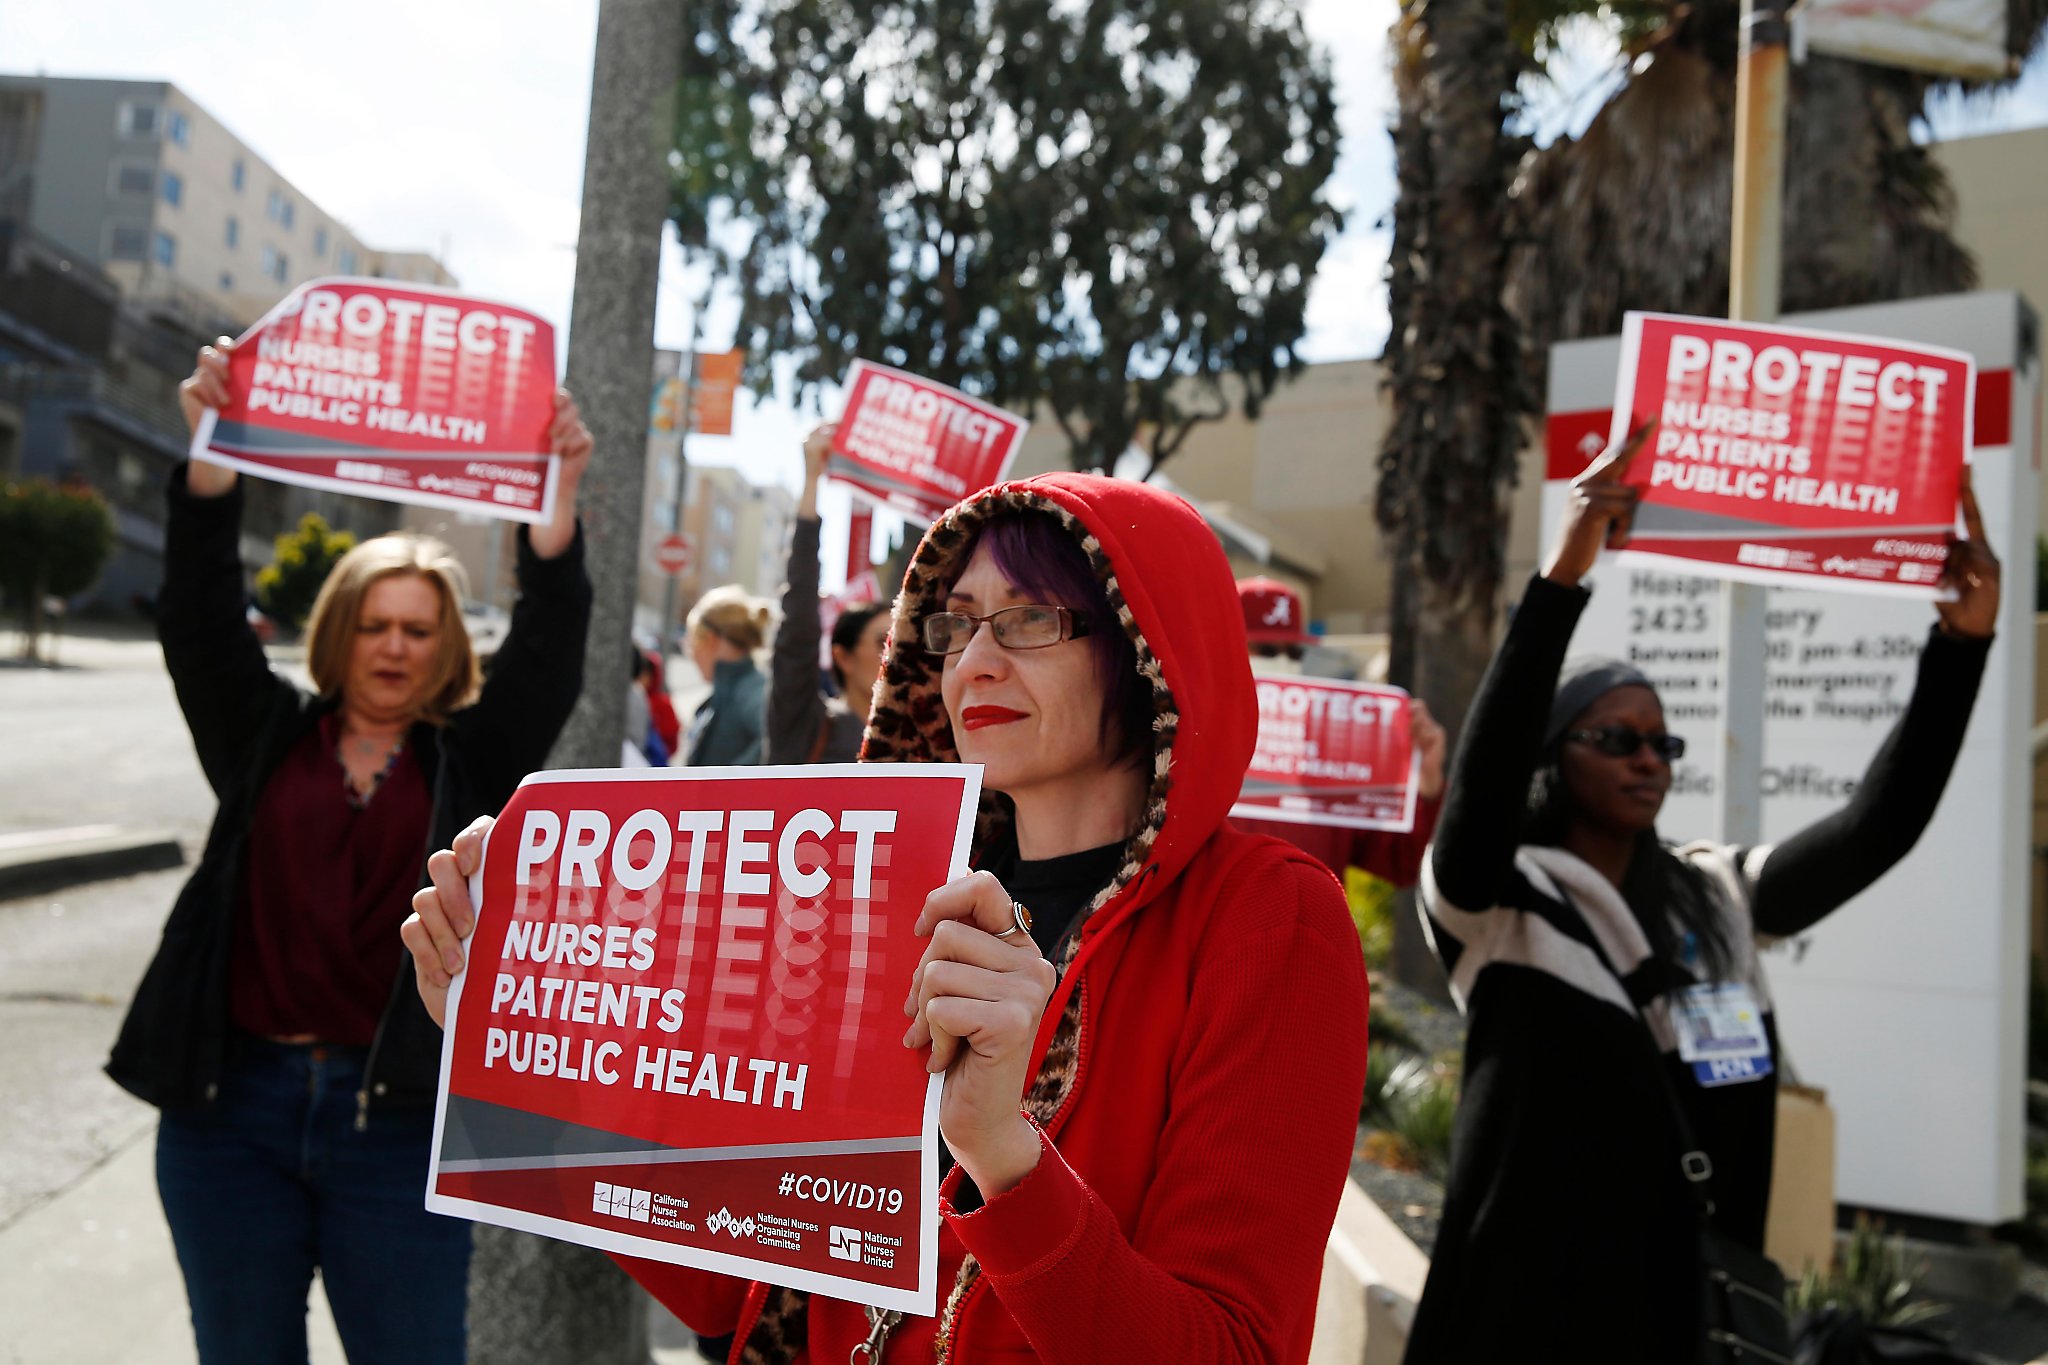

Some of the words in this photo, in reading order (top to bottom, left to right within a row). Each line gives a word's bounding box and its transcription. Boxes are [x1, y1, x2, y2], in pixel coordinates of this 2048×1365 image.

[258, 336, 381, 377] NURSES
[1666, 334, 1948, 415] PROTECT
[253, 362, 402, 406] PATIENTS
[247, 387, 361, 425] PUBLIC
[366, 406, 487, 444] HEALTH
[863, 374, 1006, 451] PROTECT
[1661, 400, 1791, 440] NURSES
[1656, 430, 1812, 474] PATIENTS
[1651, 459, 1768, 499] PUBLIC
[1773, 475, 1900, 515] HEALTH
[1631, 604, 1709, 634] 2425
[1257, 683, 1402, 726] ROTECT
[515, 809, 898, 899] PROTECT
[501, 920, 658, 971] NURSES
[490, 973, 686, 1034] PATIENTS
[484, 1027, 623, 1086] PUBLIC
[633, 1045, 809, 1112] HEALTH
[652, 1205, 678, 1218] Nurses
[653, 1193, 690, 1210] California
[778, 1171, 904, 1215] #COVID19
[651, 1215, 697, 1232] Association
[757, 1212, 791, 1228] National
[791, 1218, 819, 1232] Nurses
[757, 1223, 801, 1242] Organizing
[864, 1231, 903, 1247] National
[757, 1237, 801, 1252] Committee
[864, 1243, 895, 1258] Nurses
[864, 1255, 894, 1269] United
